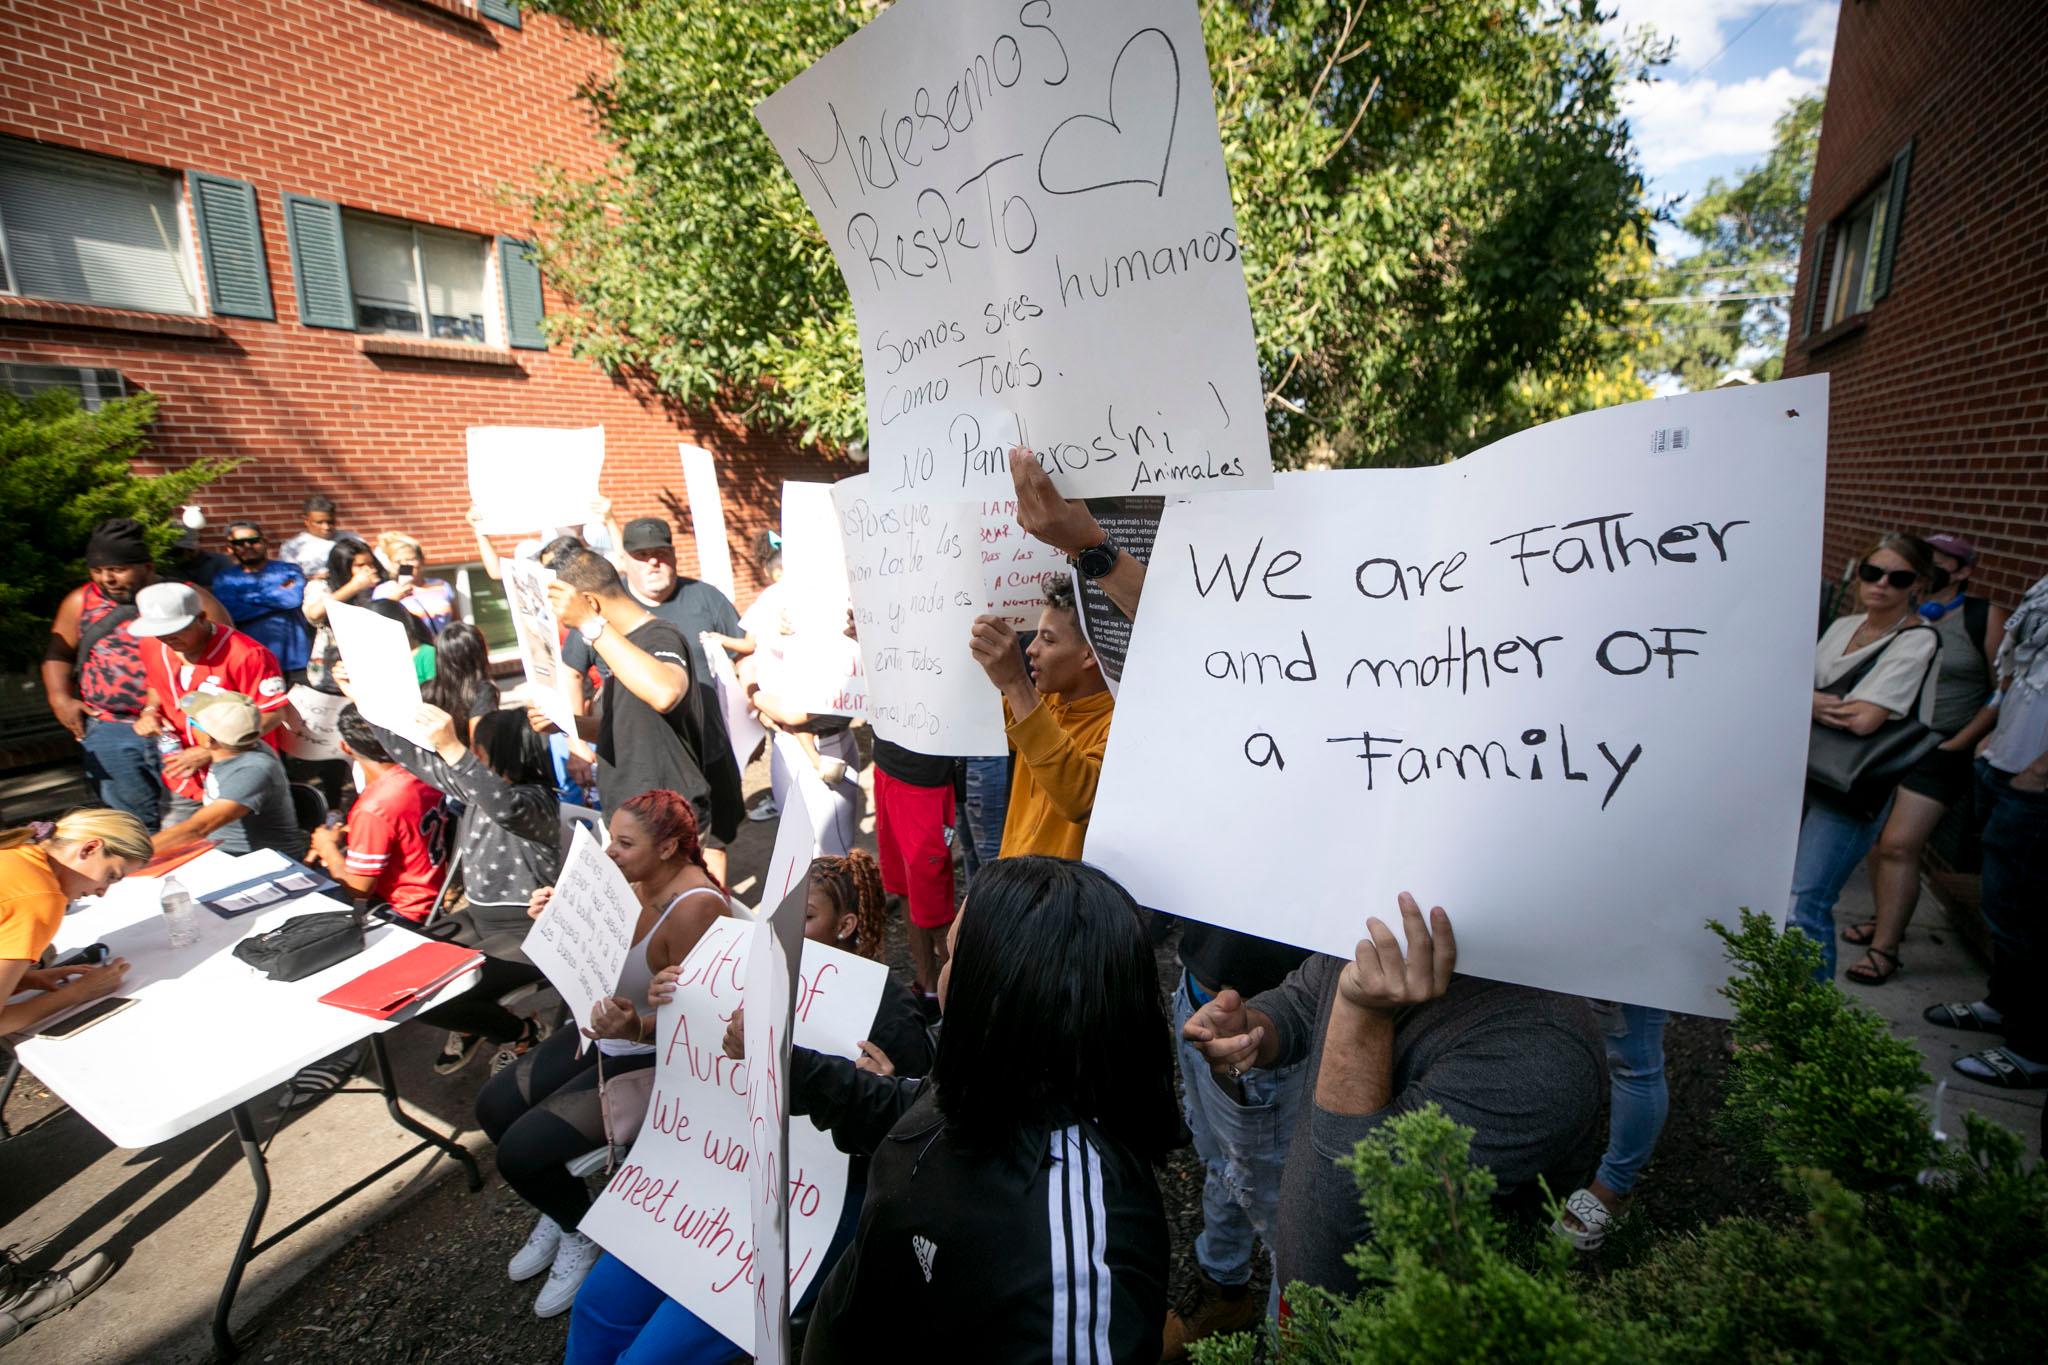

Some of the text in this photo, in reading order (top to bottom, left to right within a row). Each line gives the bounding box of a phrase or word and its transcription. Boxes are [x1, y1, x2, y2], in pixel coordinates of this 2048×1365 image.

[1056, 227, 1239, 308] humanos
[1110, 527, 1137, 535] colorado
[1117, 517, 1140, 526] animals
[1188, 536, 1312, 602] We
[1355, 550, 1468, 601] are
[1346, 625, 1564, 695] mother
[1244, 731, 1285, 772] a
[652, 1089, 692, 1142] We
[673, 1206, 735, 1257] with
[912, 1234, 933, 1284] adidas
